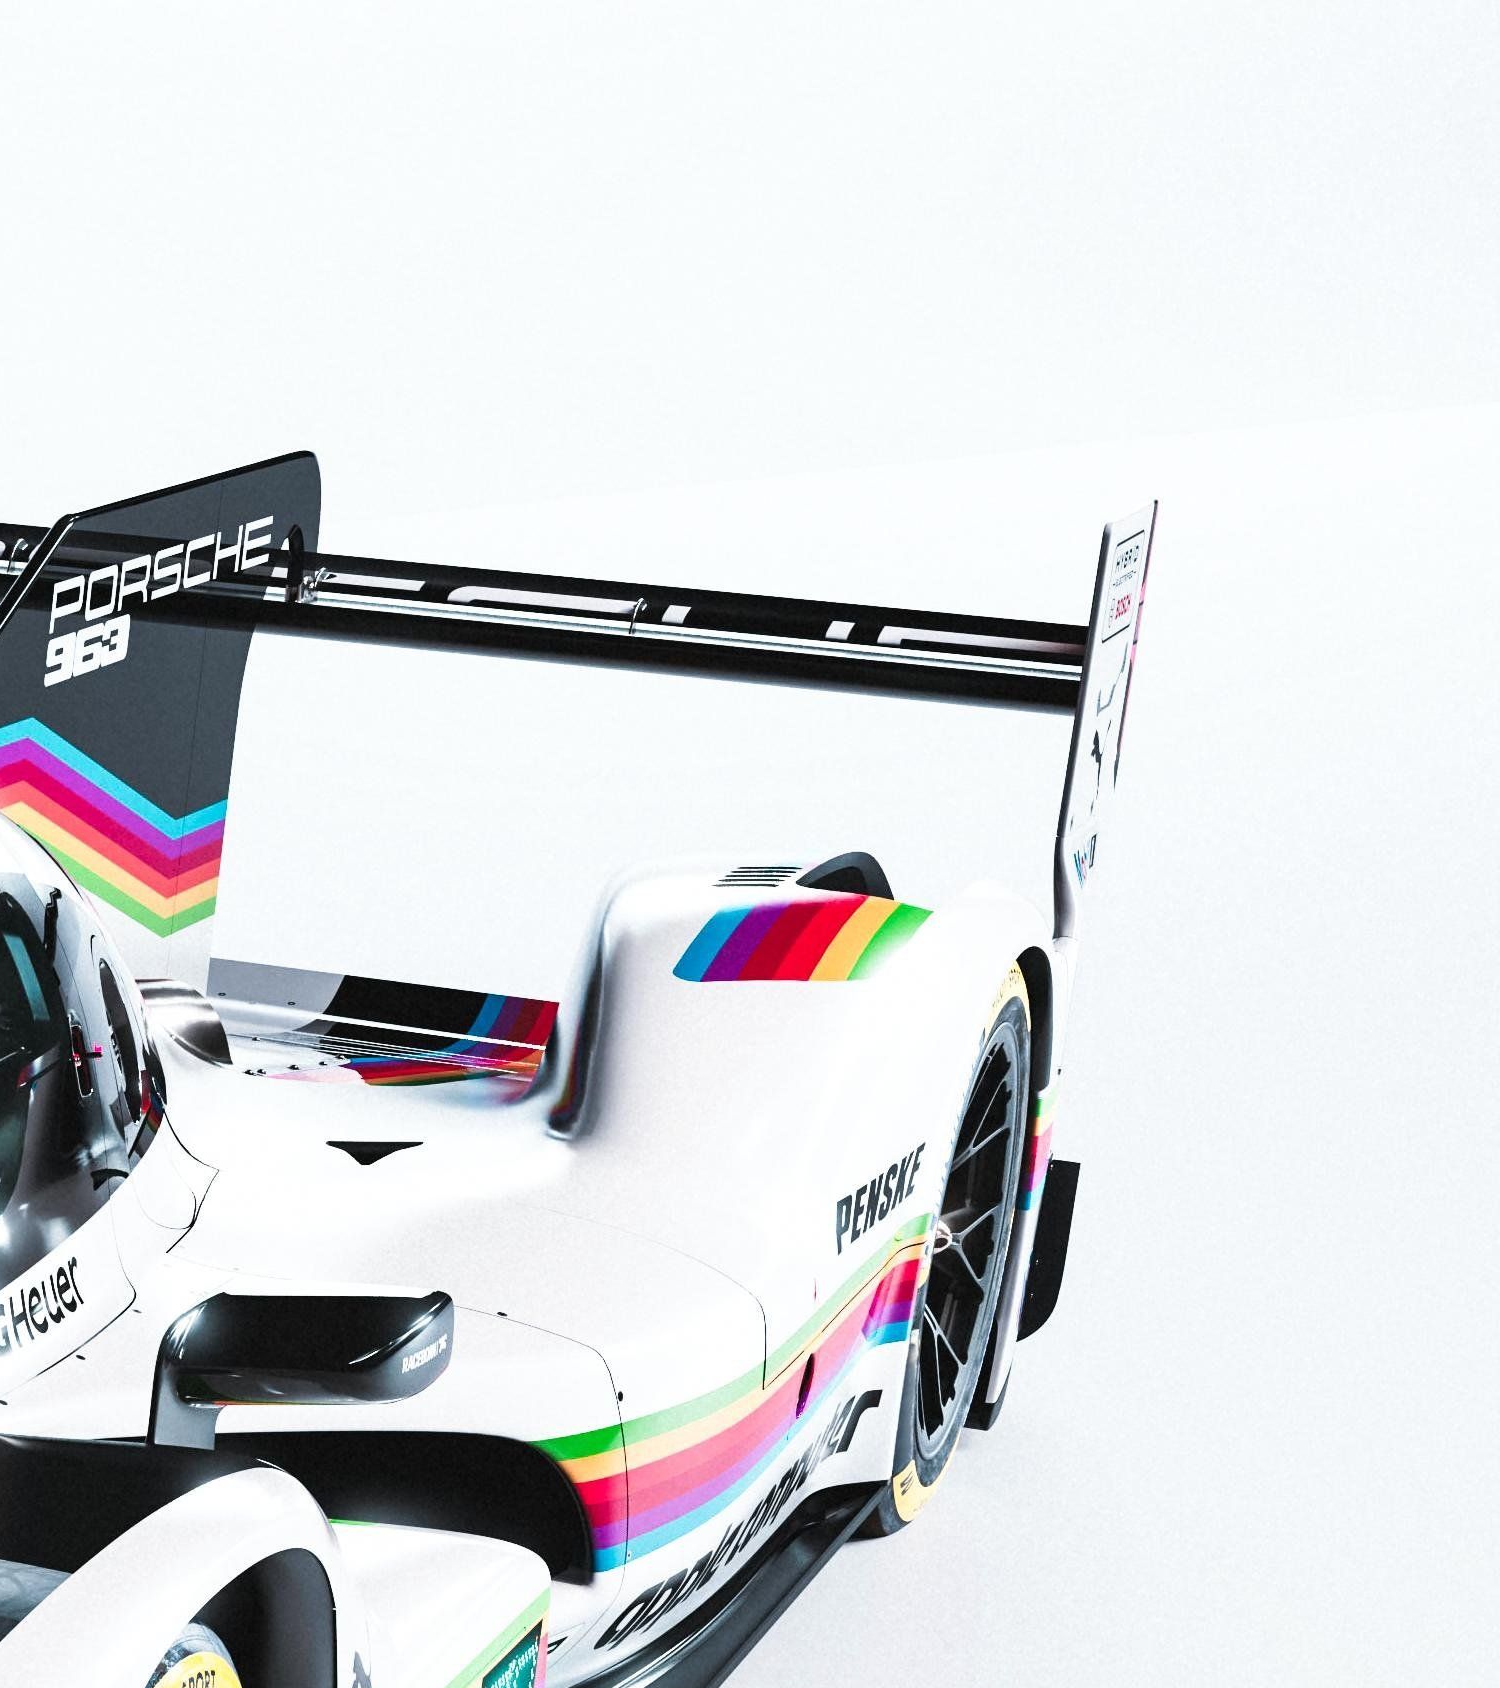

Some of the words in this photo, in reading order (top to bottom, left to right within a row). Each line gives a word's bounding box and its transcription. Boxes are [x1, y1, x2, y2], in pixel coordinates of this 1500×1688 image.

[49, 515, 274, 633] PORSCHE
[44, 614, 131, 688] 963
[836, 1142, 926, 1255] PENSKE
